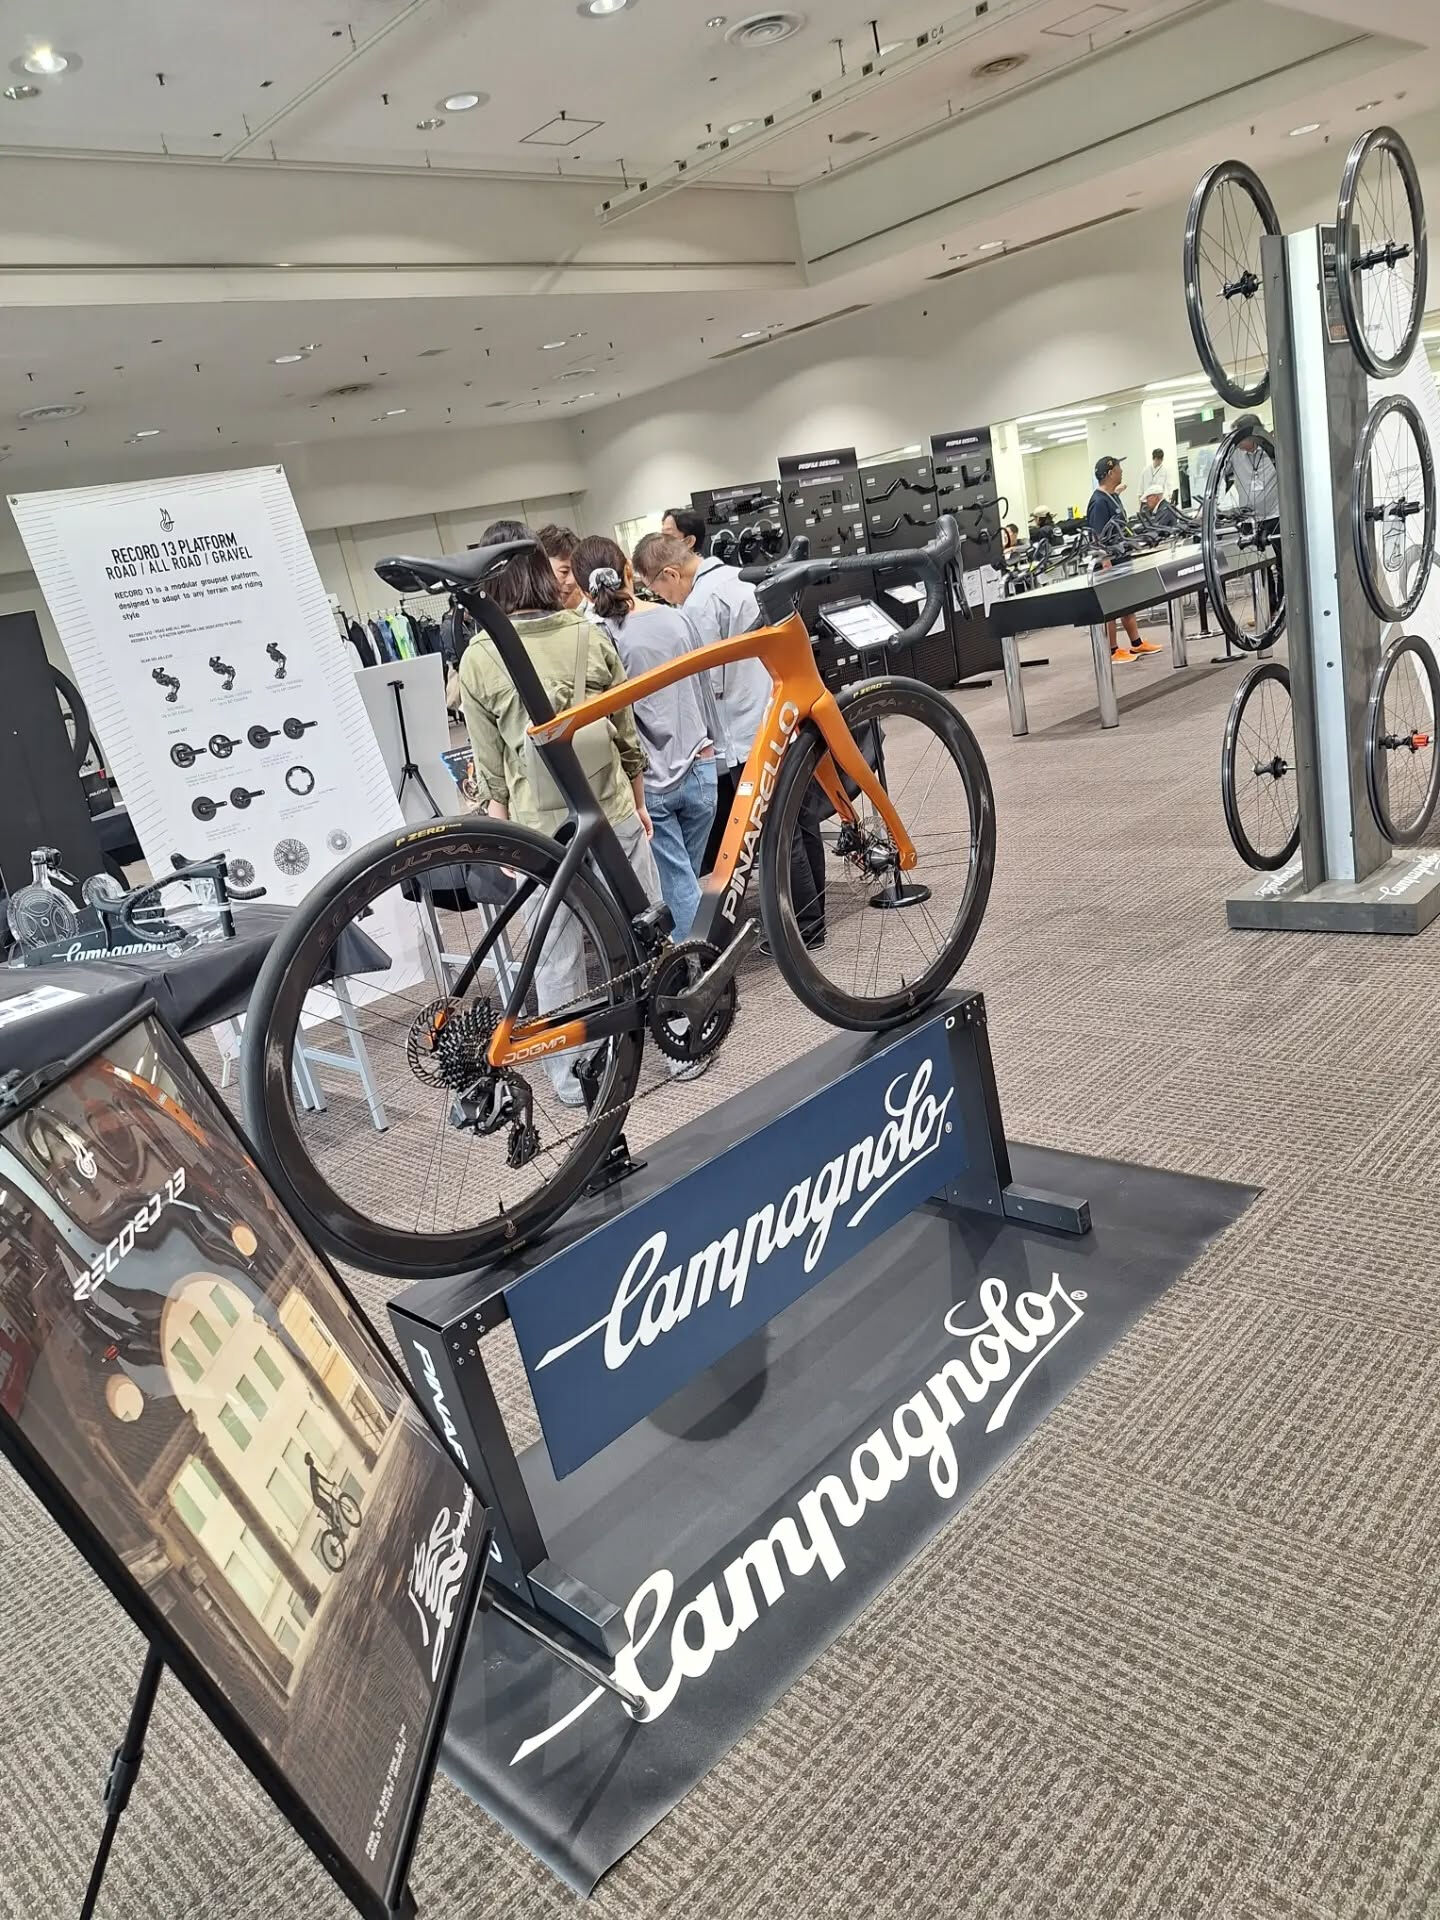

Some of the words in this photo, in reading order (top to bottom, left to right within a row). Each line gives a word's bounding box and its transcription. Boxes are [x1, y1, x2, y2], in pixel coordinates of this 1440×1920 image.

[105, 563, 137, 580] ROAD
[149, 559, 170, 574] ALL
[172, 554, 201, 570] ROAD
[211, 546, 253, 564] GRAVEL
[111, 543, 160, 565] RECORD
[161, 541, 177, 557] 13
[177, 532, 238, 555] PLATFORM
[114, 588, 143, 600] RECORD
[145, 586, 153, 595] 13
[155, 585, 162, 593] is
[171, 581, 198, 591] modular
[200, 576, 229, 587] groupset
[119, 599, 150, 610] designed
[152, 597, 160, 605] to
[162, 594, 181, 604] adapt
[183, 592, 191, 600] to
[192, 590, 205, 599] any
[207, 586, 229, 596] terrain
[231, 583, 243, 592] and
[244, 579, 263, 589] riding
[122, 611, 141, 621] style
[722, 701, 800, 925] PINARELLO
[395, 837, 405, 848] P
[408, 825, 447, 841] ZERO
[501, 1035, 567, 1065] DOGMA
[535, 1059, 954, 1371] Campagnolo
[73, 1193, 161, 1301] RECORD
[165, 1167, 186, 1203] 13
[509, 1273, 1084, 1766] Campagnolo
